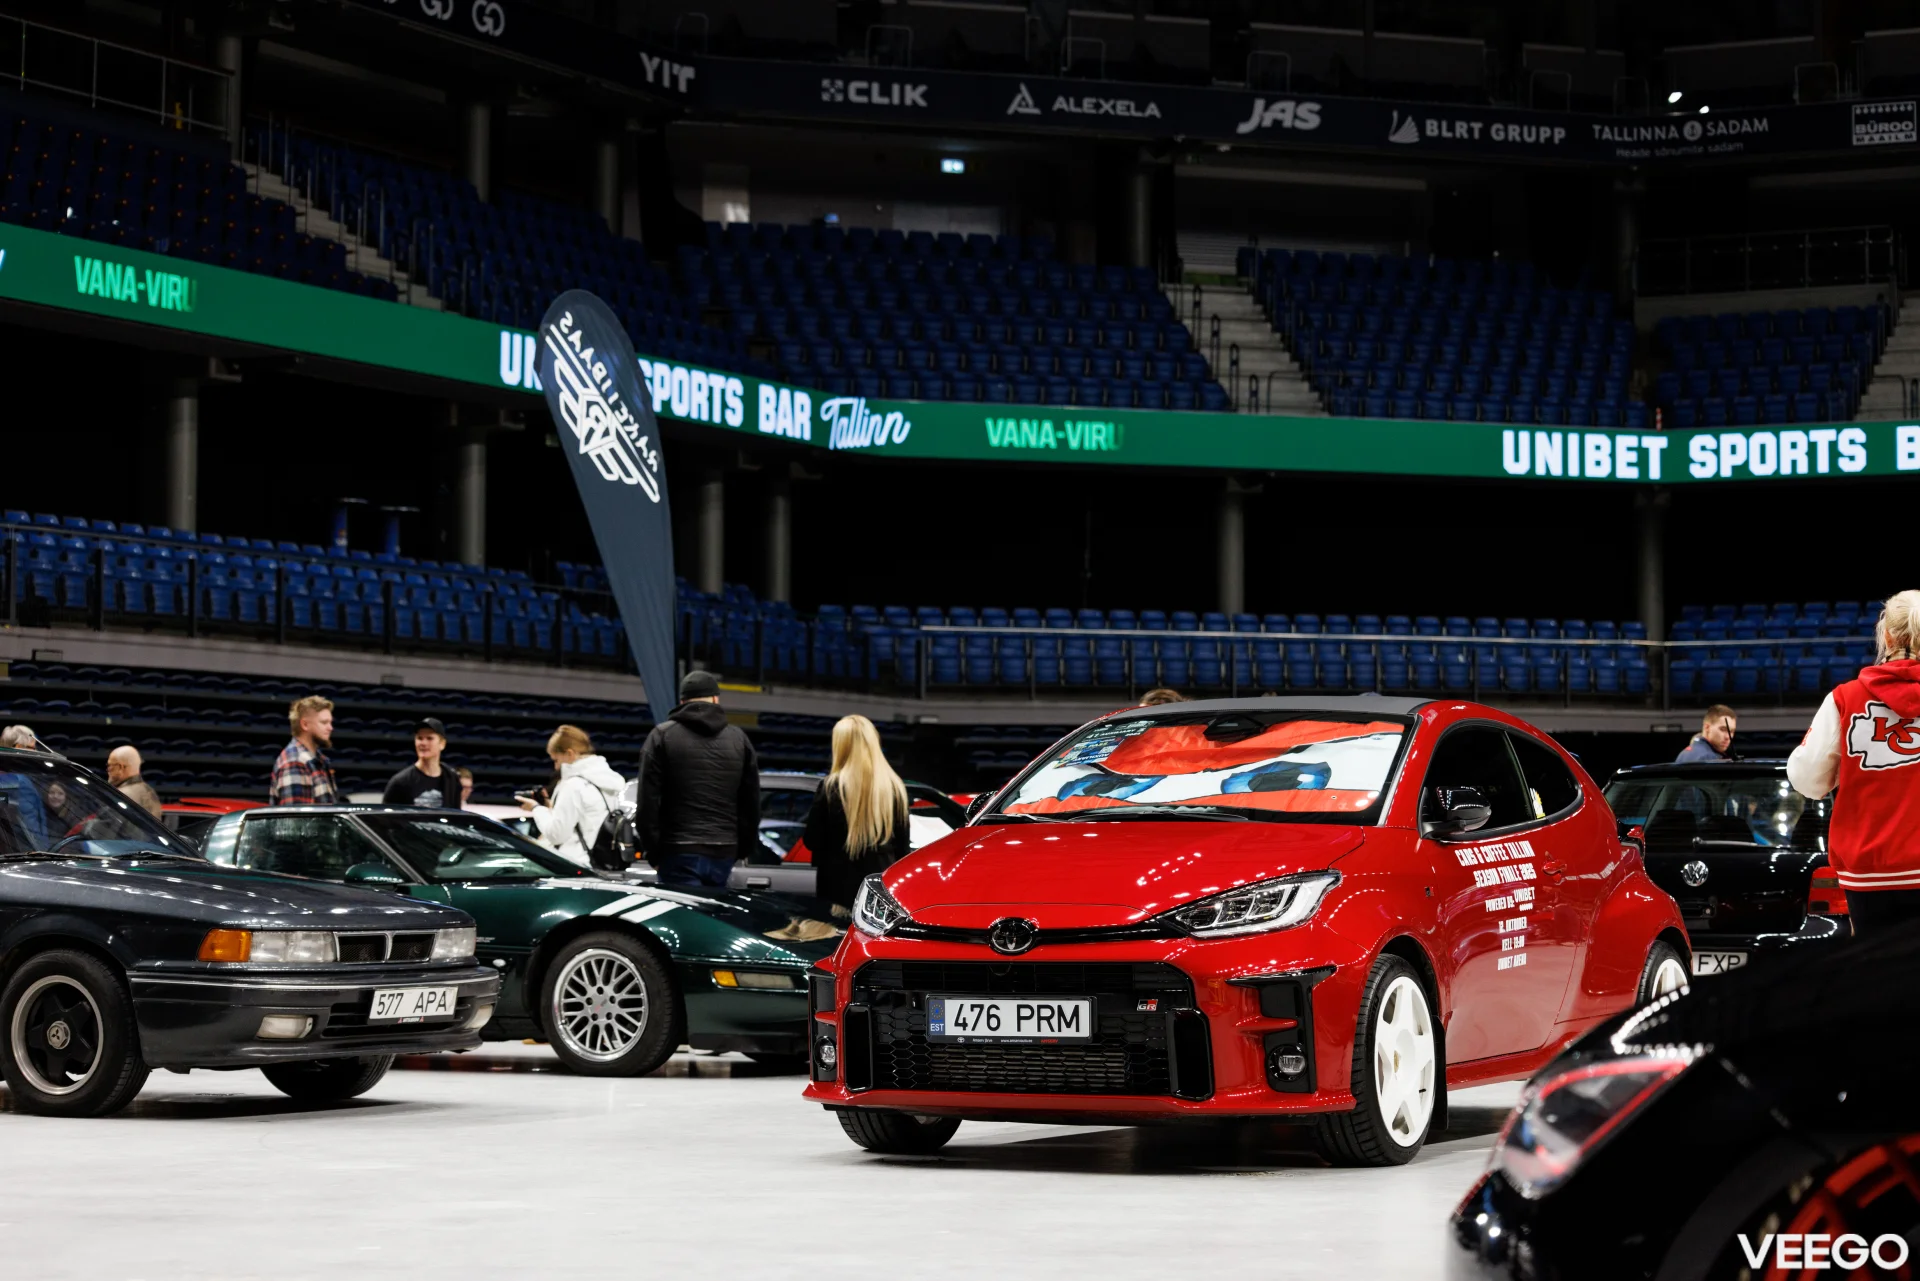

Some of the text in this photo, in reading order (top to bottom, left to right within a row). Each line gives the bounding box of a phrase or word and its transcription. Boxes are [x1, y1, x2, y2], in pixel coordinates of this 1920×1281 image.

[640, 52, 695, 93] YIT
[848, 81, 928, 107] CLIK
[1052, 96, 1162, 119] ALEXELA
[1236, 98, 1322, 134] JAS
[1425, 119, 1566, 144] BLRT GRUPP
[1592, 117, 1769, 142] TALLINNA SADAM
[1855, 119, 1914, 134] BÜROO
[1855, 133, 1914, 143] MAAILM
[758, 384, 812, 441] BAR
[820, 396, 912, 451] Tallinn
[1502, 429, 1668, 480] UNIBET
[1689, 428, 1867, 479] SPORTS
[1455, 847, 1478, 866] CARS
[1480, 844, 1509, 862] COFFEE
[1473, 867, 1501, 888] SEASON
[1497, 864, 1522, 883] FINALE
[1485, 897, 1507, 912] POWERED
[1514, 887, 1535, 903] UNIBET
[1697, 954, 1741, 973] FXP
[376, 991, 447, 1016] 577 APA
[930, 1023, 944, 1032] EST
[953, 1003, 1080, 1033] 476 PRM
